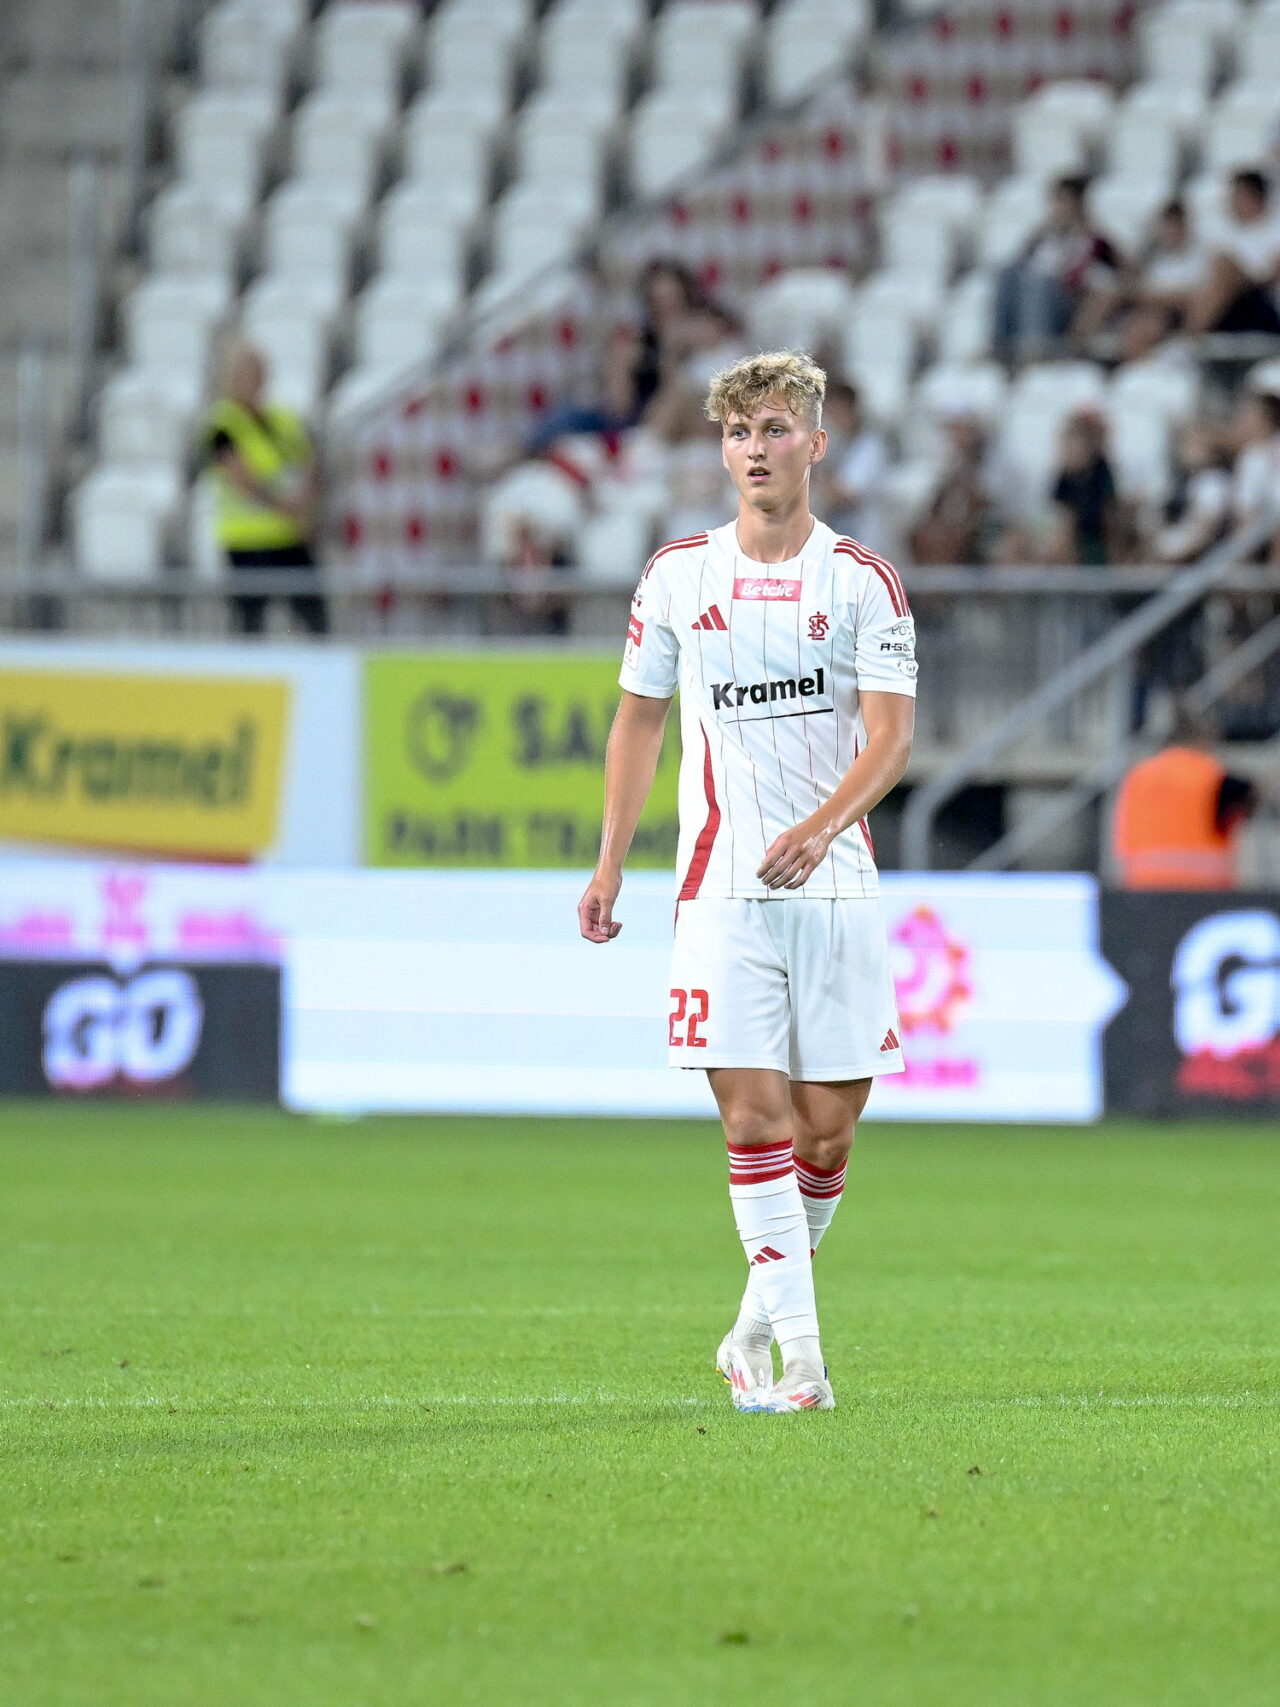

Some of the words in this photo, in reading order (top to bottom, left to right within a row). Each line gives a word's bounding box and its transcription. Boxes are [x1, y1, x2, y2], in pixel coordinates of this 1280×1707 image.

[741, 582, 795, 598] Betclic
[710, 667, 825, 710] Kramel
[41, 970, 204, 1090] GO
[669, 988, 708, 1047] 22
